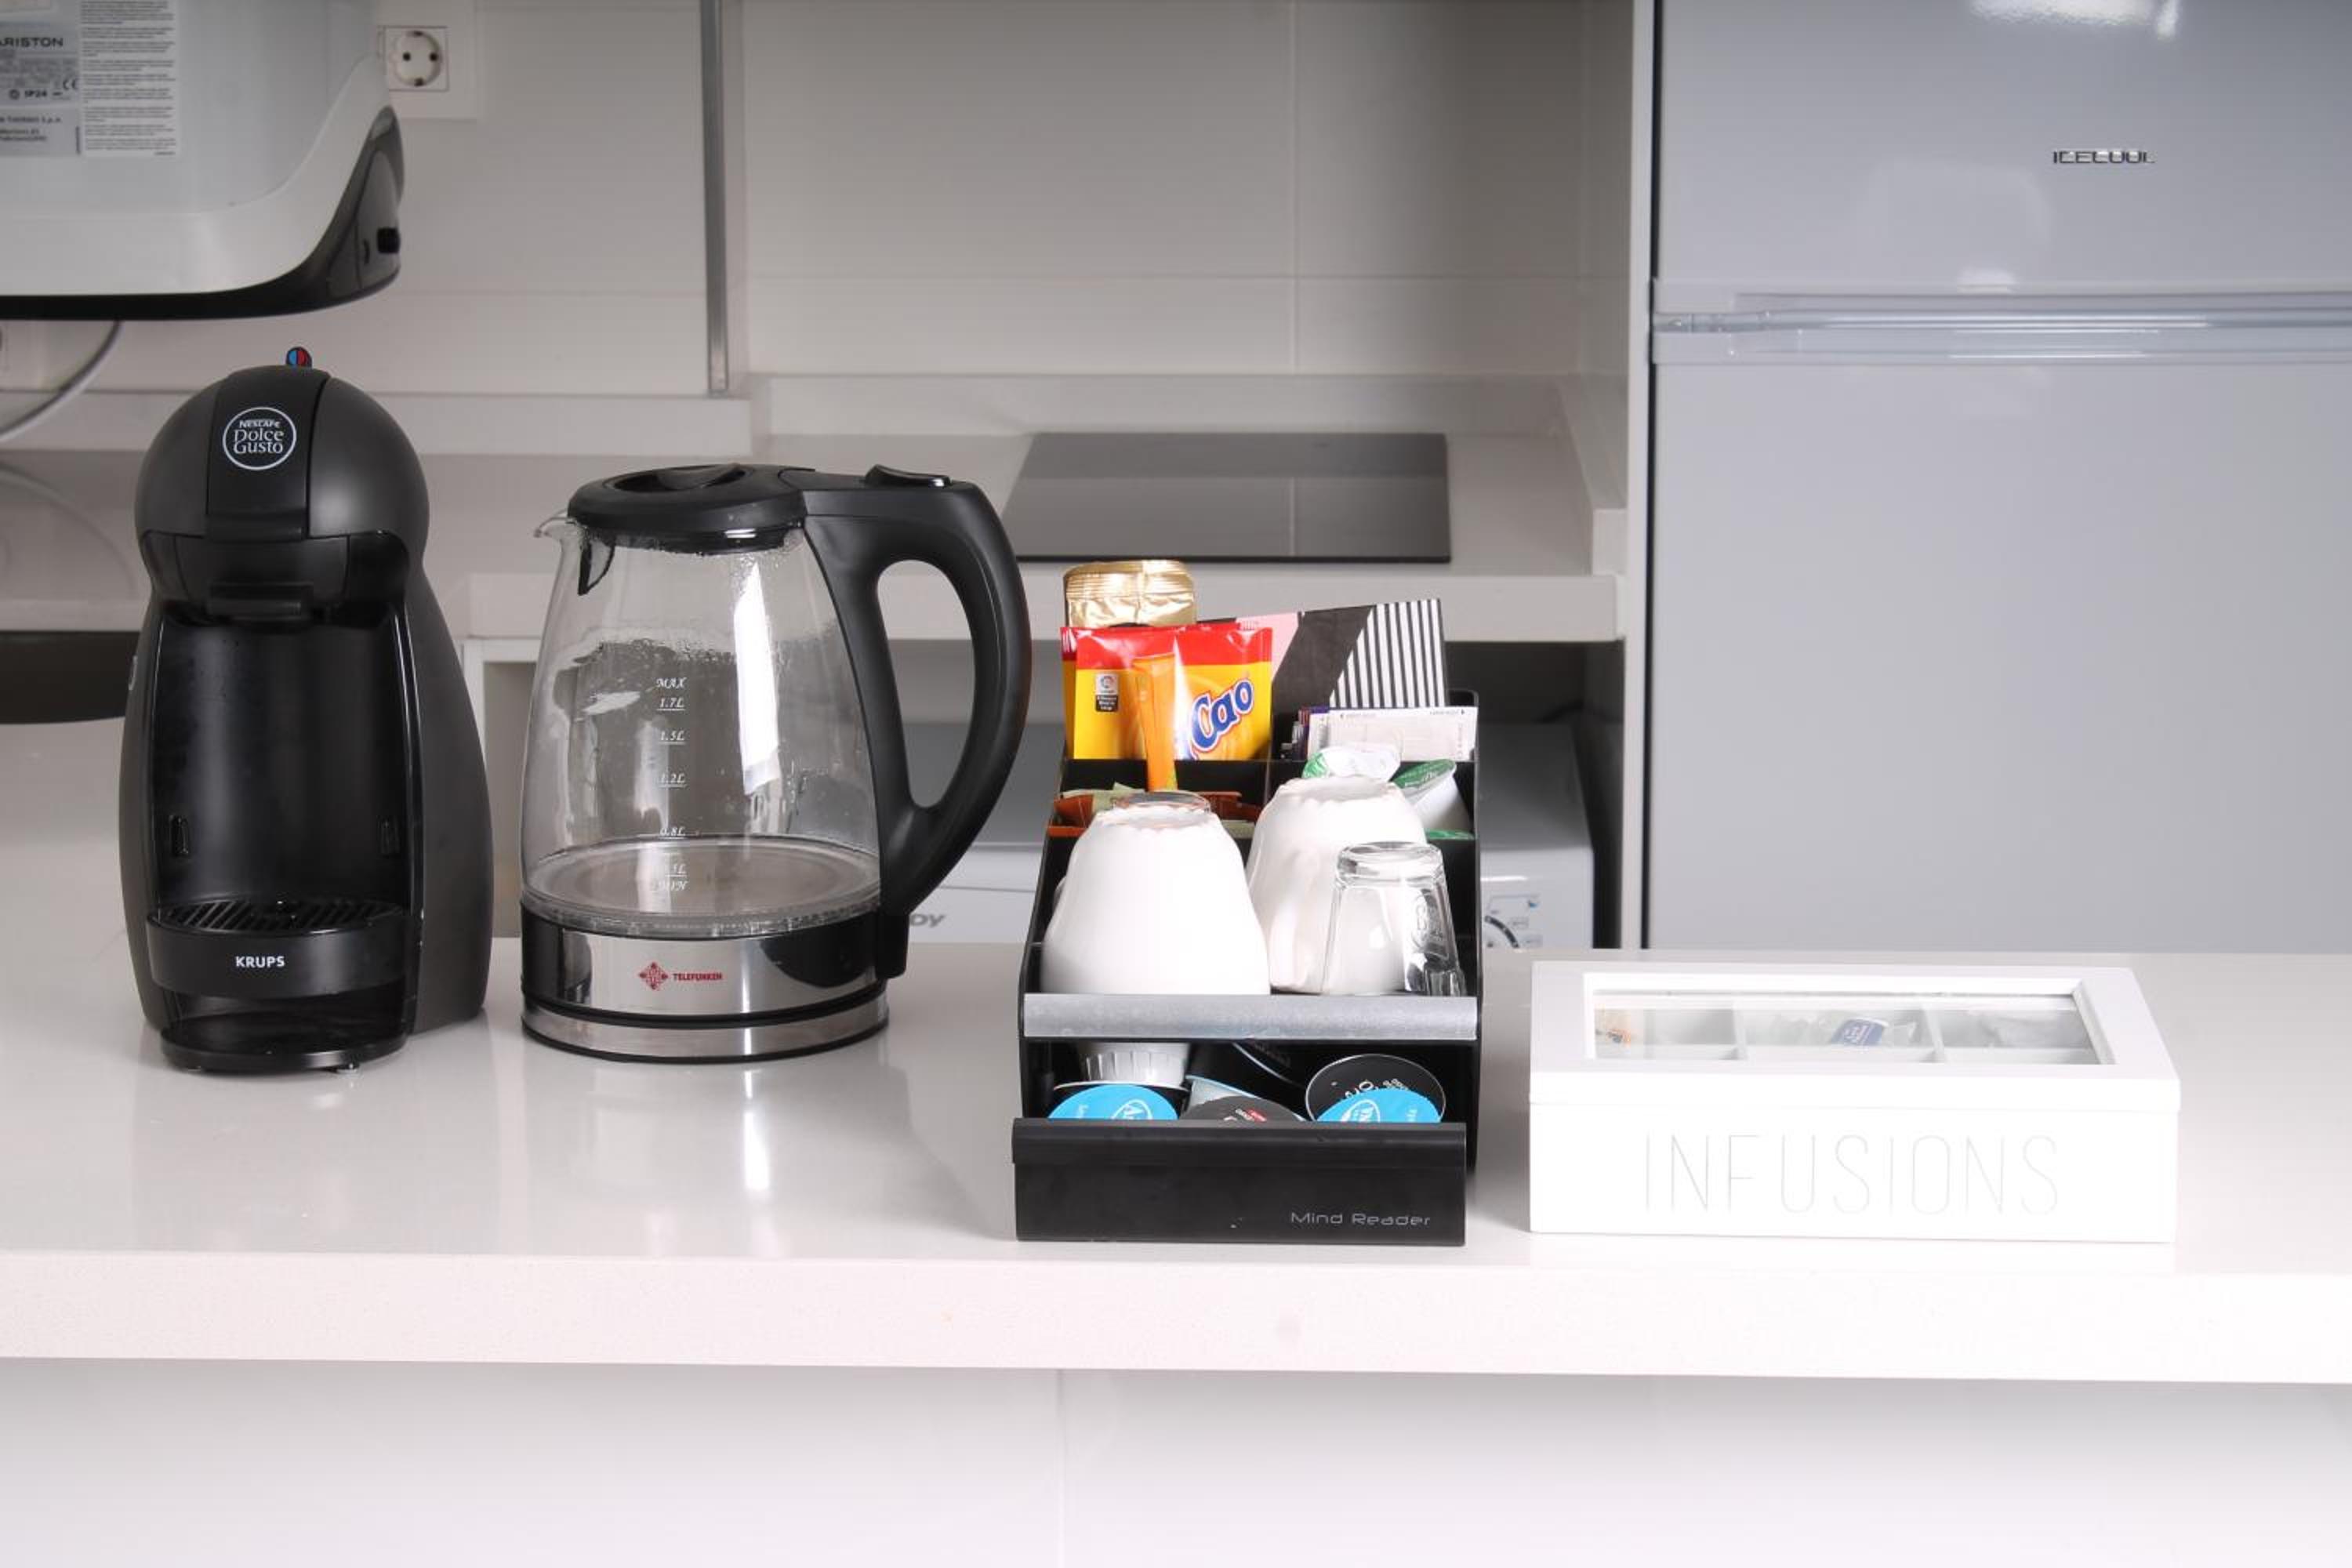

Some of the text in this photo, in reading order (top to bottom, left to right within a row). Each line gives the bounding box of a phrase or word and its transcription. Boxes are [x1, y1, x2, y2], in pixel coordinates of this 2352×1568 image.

[2053, 151, 2155, 164] ICECOOL
[234, 428, 284, 442] Dolce
[234, 441, 283, 454] Gusto
[656, 677, 688, 689] MAX
[1189, 678, 1254, 751] Cao
[235, 956, 285, 968] KRUPS
[1645, 1134, 2059, 1216] INFUSIONS
[1291, 1212, 1431, 1226] Mind Reader
